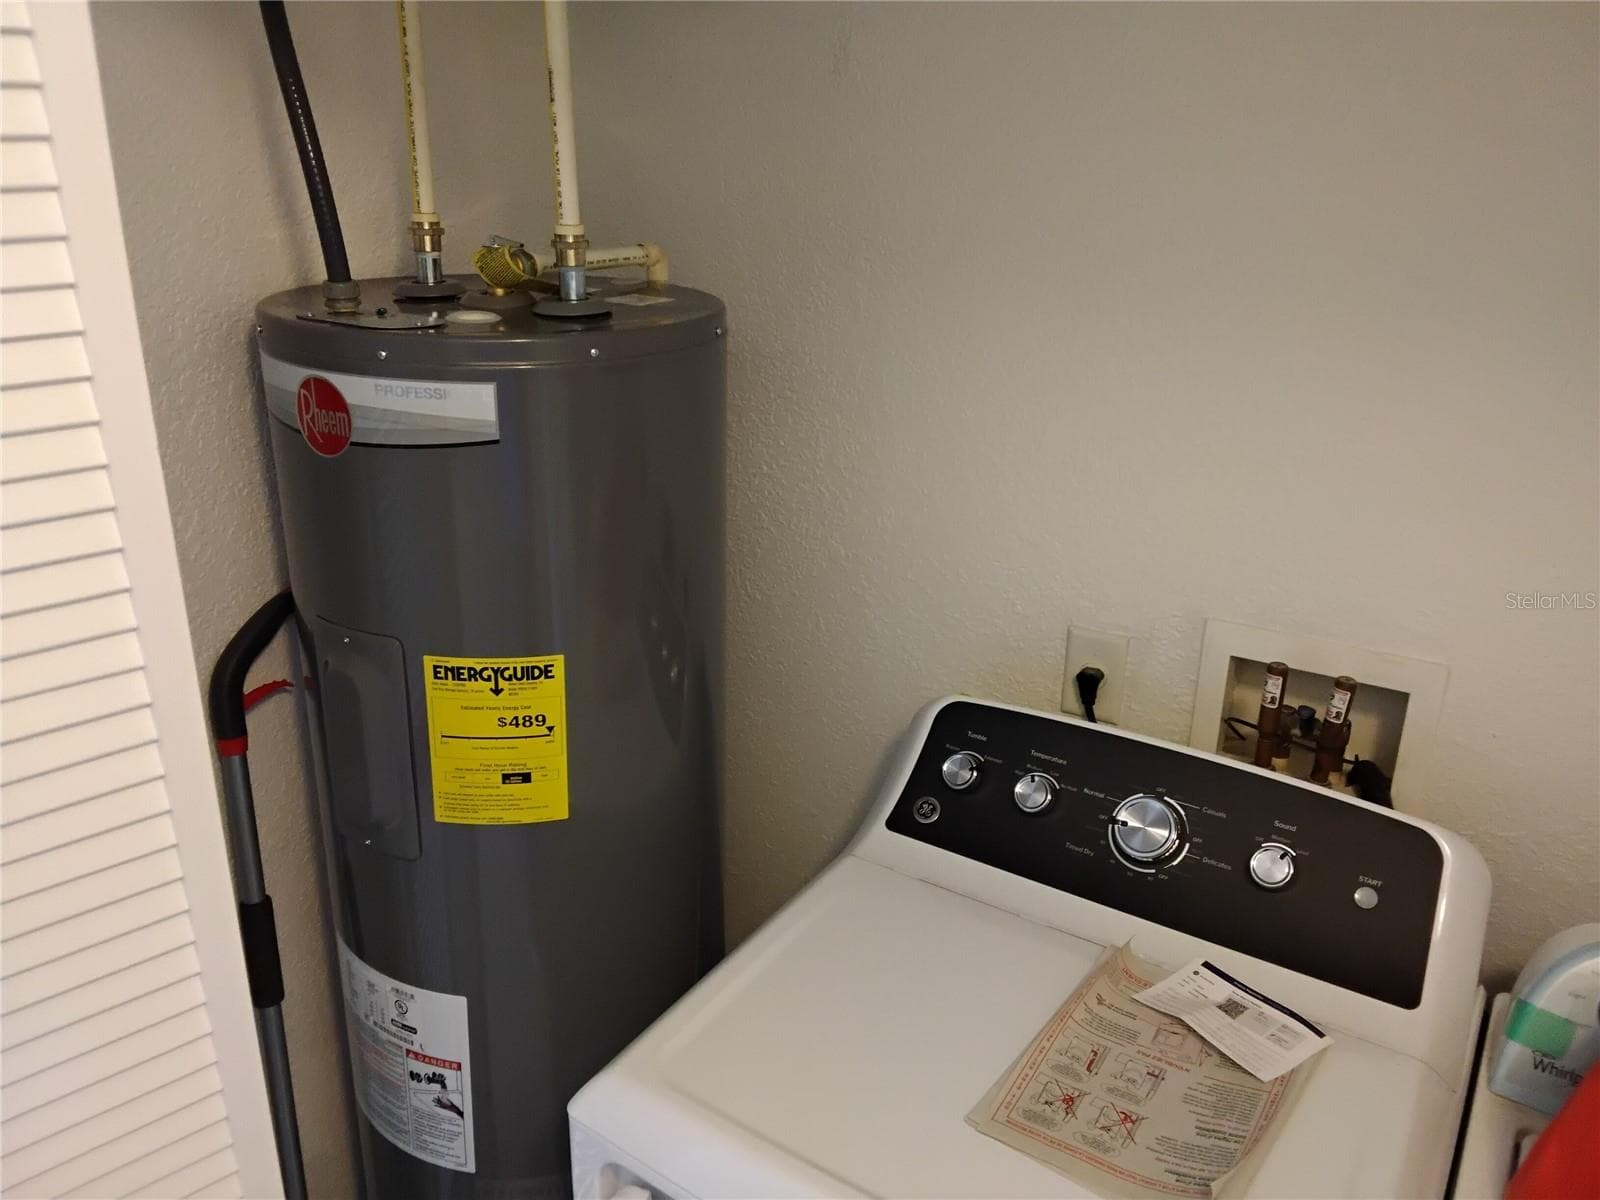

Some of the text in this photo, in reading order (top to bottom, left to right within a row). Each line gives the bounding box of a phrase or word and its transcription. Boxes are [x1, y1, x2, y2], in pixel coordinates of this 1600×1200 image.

[299, 377, 351, 443] Rheem
[432, 664, 555, 683] ENERGYGUIDE
[497, 713, 547, 729] $489
[968, 731, 987, 741] Tumble
[1030, 749, 1068, 765] Temperature
[1083, 788, 1105, 798] Normal
[1274, 820, 1297, 832] Sound
[1202, 856, 1233, 871] Delicates
[1358, 875, 1383, 887] START
[416, 1054, 458, 1070] DANGER
